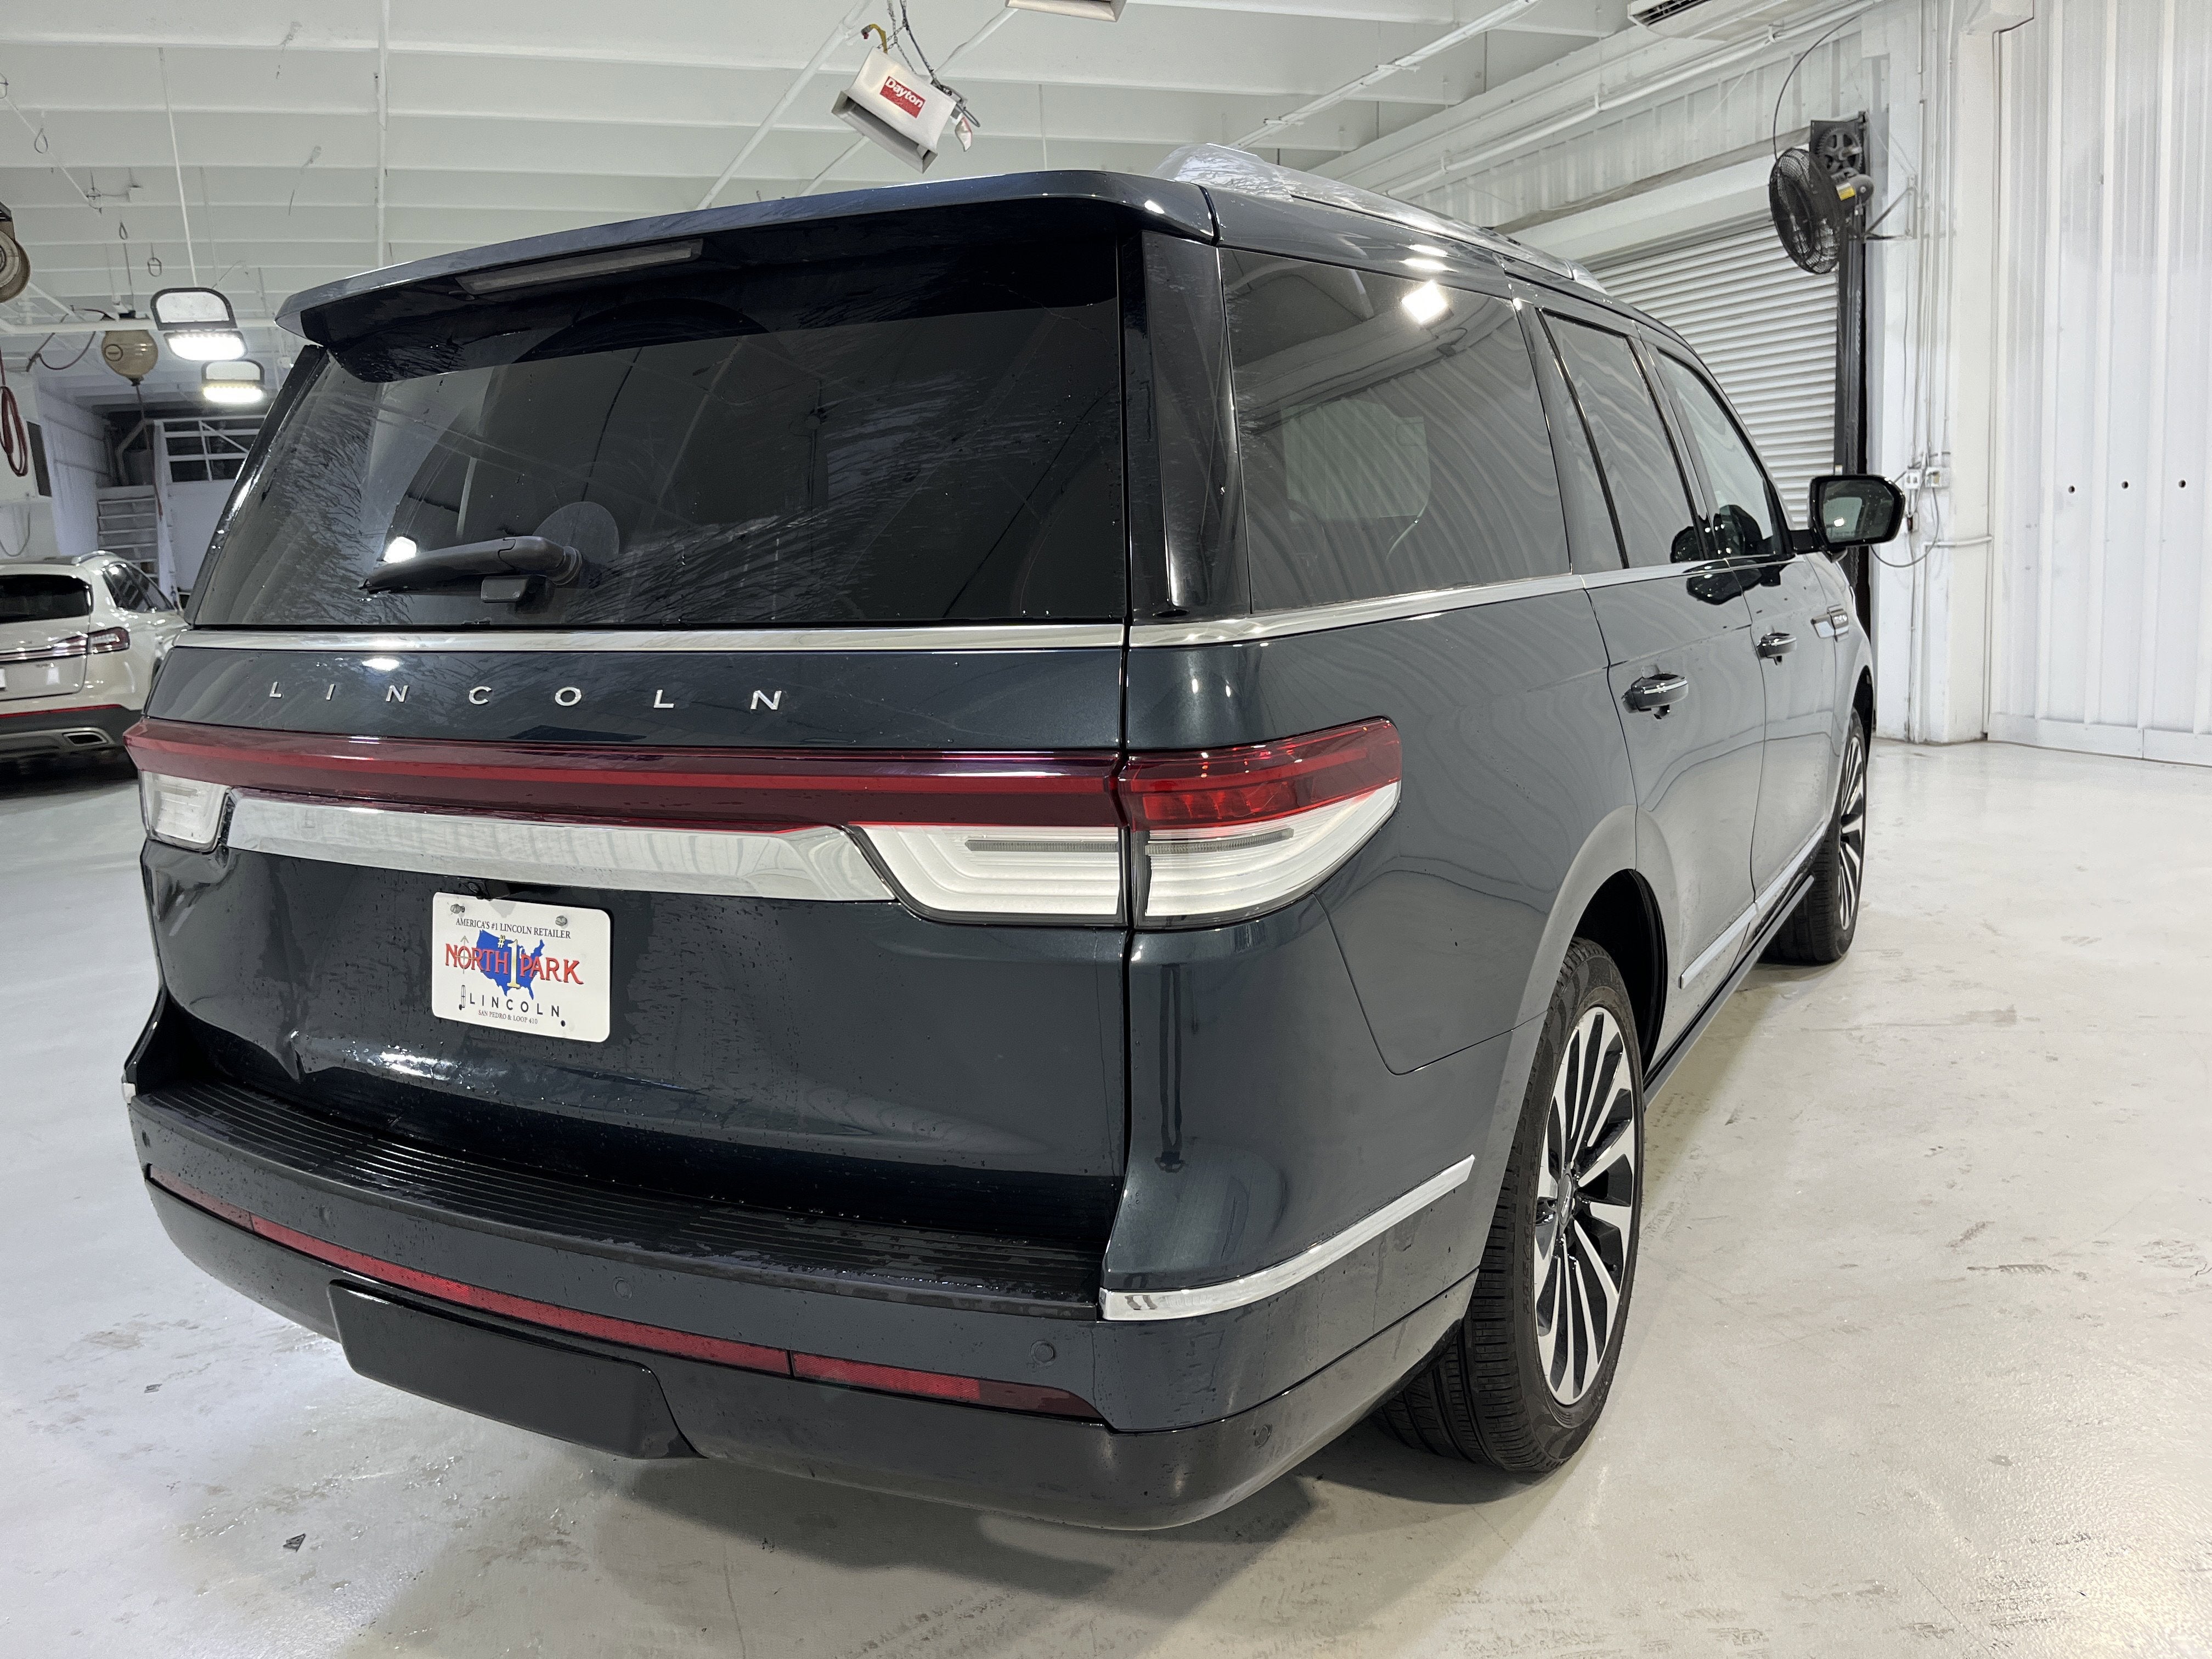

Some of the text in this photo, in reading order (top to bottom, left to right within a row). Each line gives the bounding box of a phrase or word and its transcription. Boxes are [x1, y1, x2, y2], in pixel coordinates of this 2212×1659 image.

[885, 77, 924, 108] Dayton
[269, 681, 782, 710] LINCOLN
[456, 917, 490, 930] AMERICA'S
[500, 923, 532, 935] LINCOLN
[533, 927, 571, 939] RETAILER
[445, 943, 509, 975] NORTH
[520, 953, 585, 985] PARK
[470, 992, 560, 1018] LINCOLN
[489, 1012, 506, 1020] PEDRO
[513, 1015, 528, 1023] LOOP
